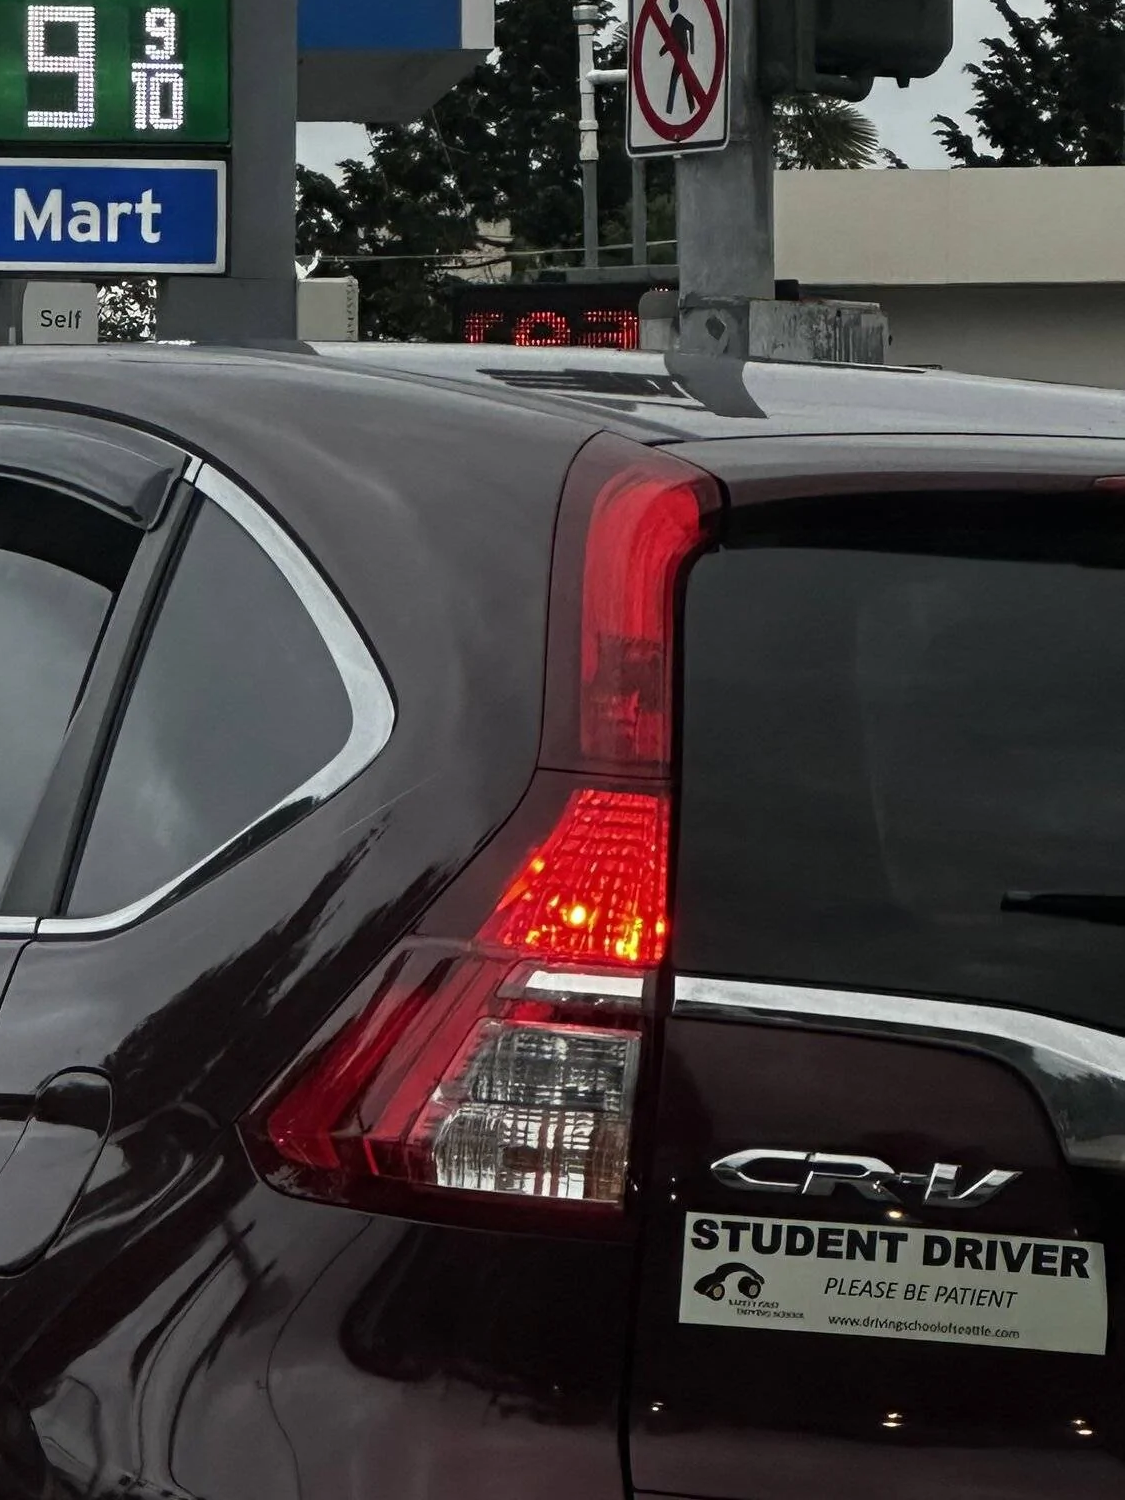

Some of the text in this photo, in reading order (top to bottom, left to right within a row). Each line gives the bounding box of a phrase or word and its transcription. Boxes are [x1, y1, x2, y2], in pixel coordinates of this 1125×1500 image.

[13, 187, 163, 244] Mart
[40, 309, 83, 330] Self
[710, 1148, 1023, 1207] CR-V
[690, 1218, 1091, 1279] STUDENT DRIVER
[824, 1277, 1018, 1309] PLEASE BE PATIENT
